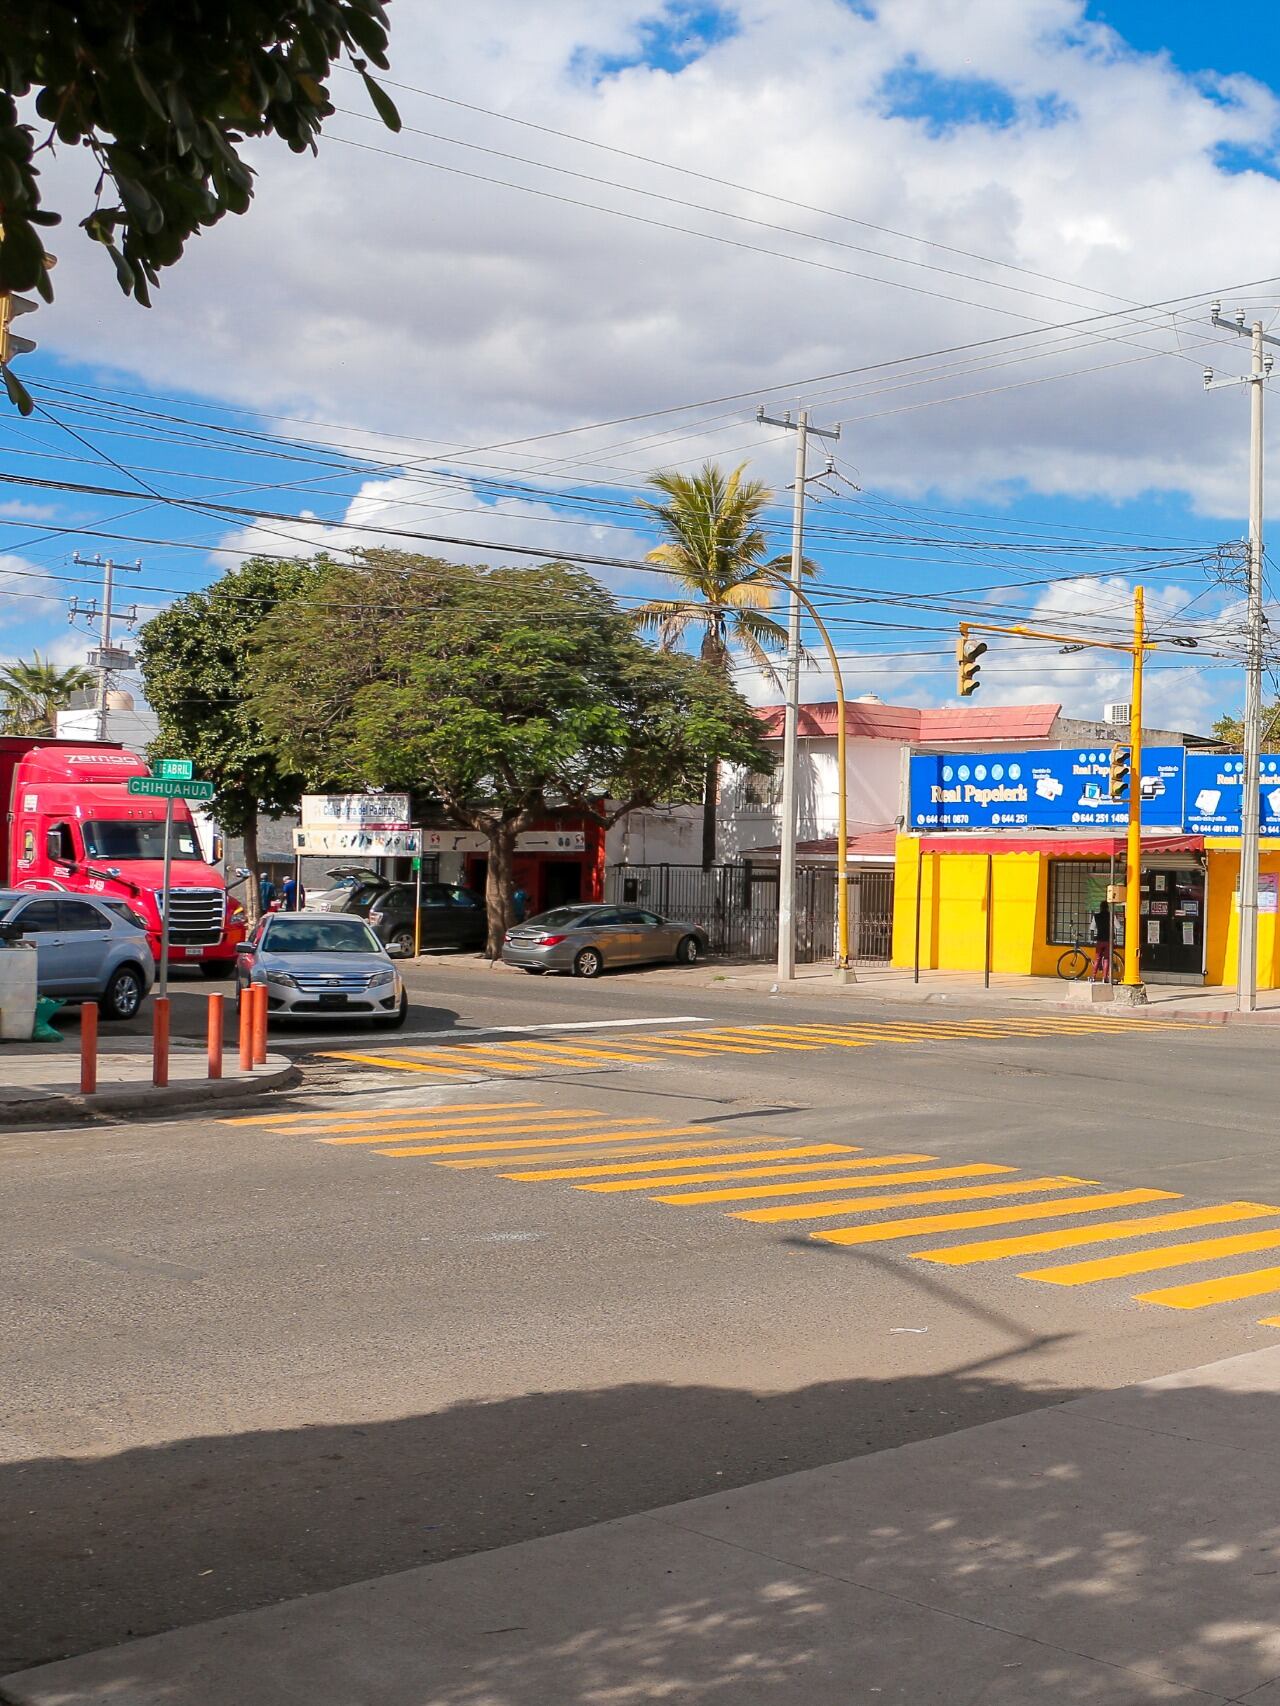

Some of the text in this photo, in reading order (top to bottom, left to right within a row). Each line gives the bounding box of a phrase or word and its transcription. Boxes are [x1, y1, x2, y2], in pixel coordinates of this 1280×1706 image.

[168, 764, 189, 774] ABRIL
[1073, 765, 1091, 775] Real
[1216, 774, 1237, 784] Real
[132, 781, 208, 796] CHIHUAHUA
[931, 785, 962, 803] Real
[926, 814, 938, 824] 644
[1002, 814, 1027, 823] 644 251
[1081, 815, 1093, 823] 644
[1095, 815, 1108, 823] 251
